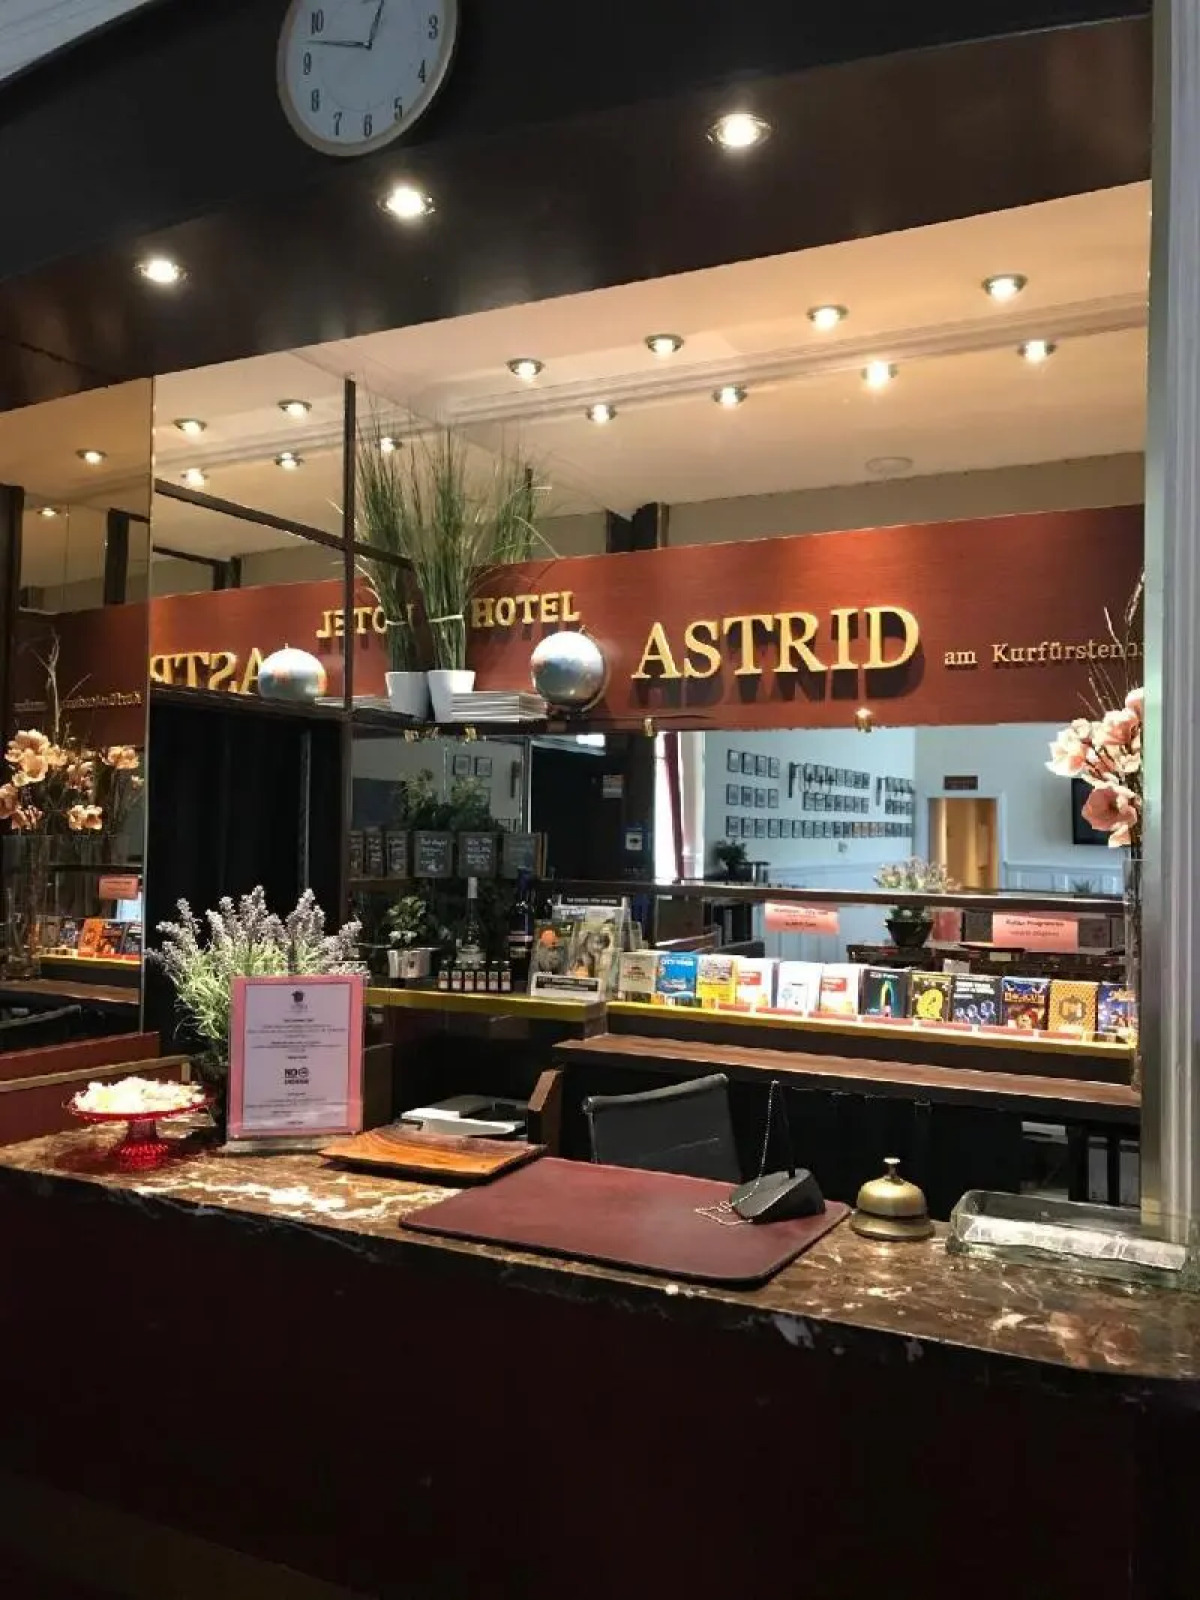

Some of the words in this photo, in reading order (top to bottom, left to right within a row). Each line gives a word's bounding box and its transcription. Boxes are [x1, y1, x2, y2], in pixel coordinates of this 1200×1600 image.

[311, 9, 325, 34] 10
[428, 15, 439, 39] 3
[303, 52, 312, 75] 9
[417, 59, 426, 83] 4
[311, 89, 320, 112] 8
[394, 97, 403, 120] 5
[333, 111, 342, 136] 7
[364, 114, 373, 137] 6
[471, 591, 581, 628] HOTEL
[631, 606, 920, 679] ASTRID
[944, 650, 978, 665] am
